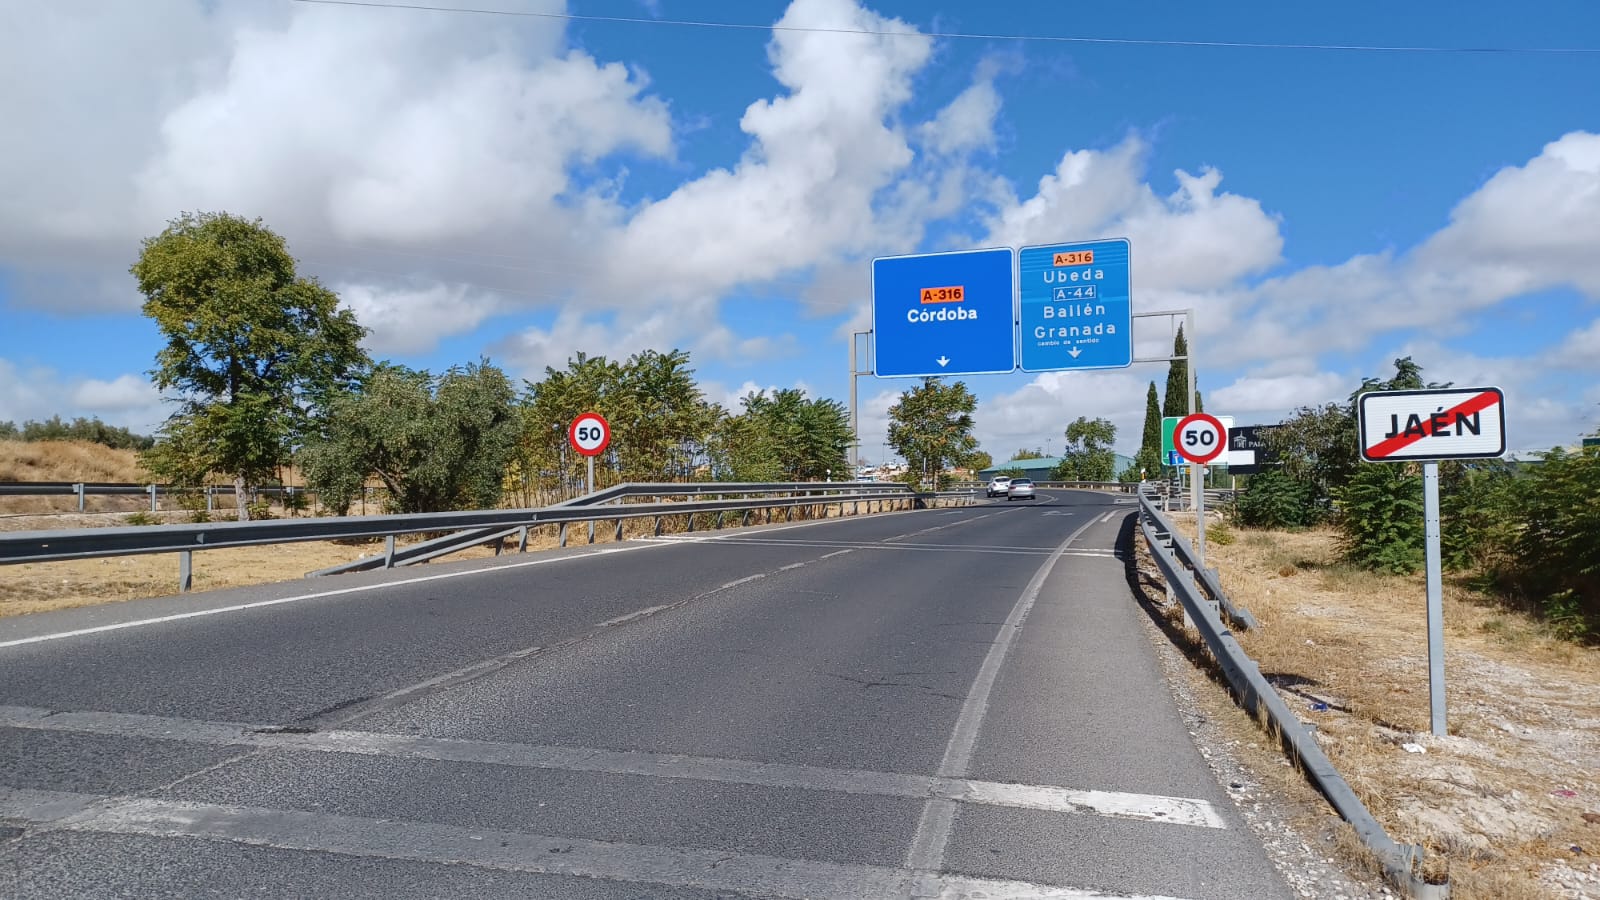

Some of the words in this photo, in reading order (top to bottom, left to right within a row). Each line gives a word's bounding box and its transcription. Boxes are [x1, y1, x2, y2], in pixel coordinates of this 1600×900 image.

[1055, 251, 1092, 264] A-316
[1043, 269, 1104, 283] Ubeda
[923, 289, 961, 301] A-316
[1056, 287, 1094, 299] A-44
[907, 307, 978, 323] Córdoba
[1043, 304, 1105, 319] Bailén
[1035, 322, 1116, 339] Granada
[1385, 406, 1481, 439] JAÉN
[578, 427, 601, 441] 50
[1185, 430, 1215, 446] 50
